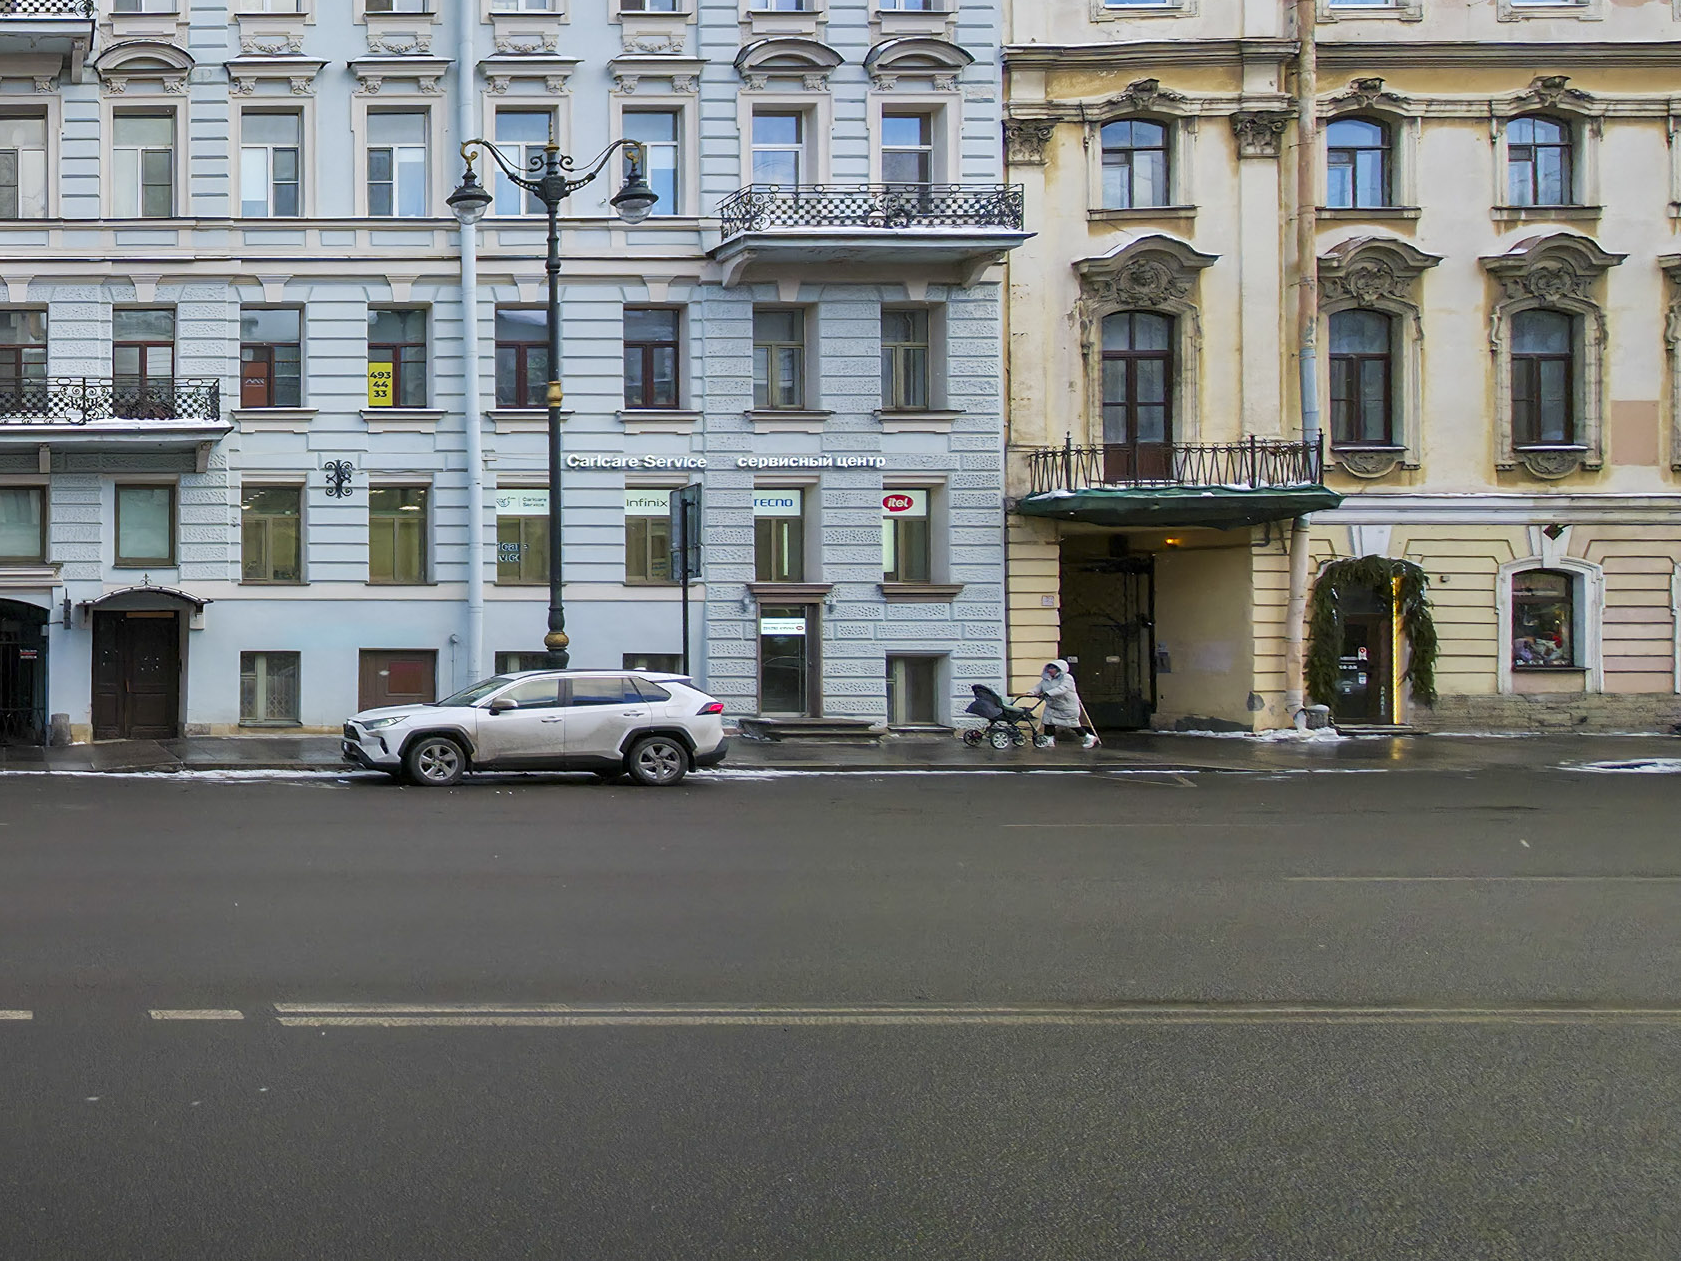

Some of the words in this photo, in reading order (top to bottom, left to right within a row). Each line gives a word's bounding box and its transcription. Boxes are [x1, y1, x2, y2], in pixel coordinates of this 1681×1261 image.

[370, 371, 391, 379] 493
[373, 380, 389, 388] 44
[373, 390, 387, 398] 33
[567, 454, 639, 468] Carlcare
[643, 454, 707, 468] Service
[737, 454, 833, 469] сервисный
[837, 455, 887, 469] центр
[626, 498, 668, 508] Infinix
[754, 498, 793, 507] TECNO
[887, 497, 909, 508] itel
